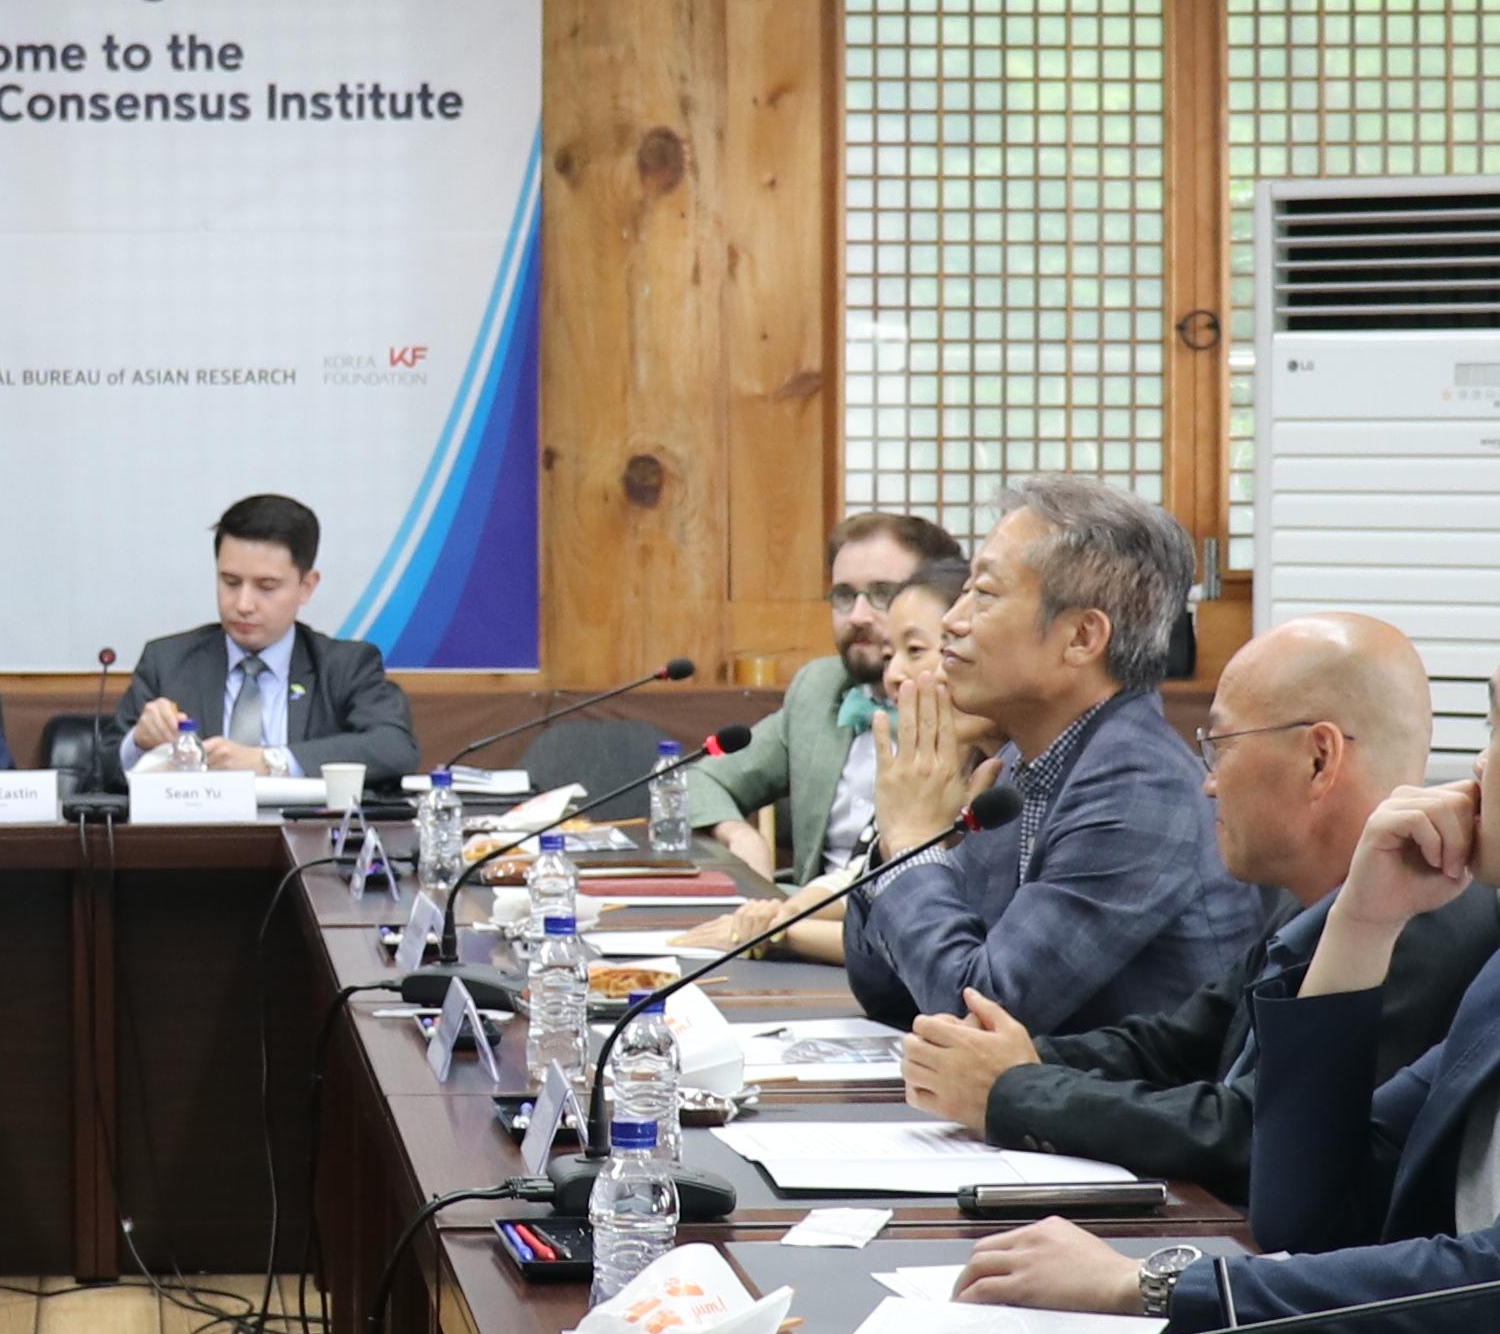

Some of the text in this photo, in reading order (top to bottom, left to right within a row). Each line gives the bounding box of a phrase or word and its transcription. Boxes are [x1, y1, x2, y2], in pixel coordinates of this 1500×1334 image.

[100, 33, 153, 73] to
[165, 33, 245, 73] the
[266, 81, 465, 122] Institute
[322, 345, 430, 369] KOREA KF
[21, 368, 101, 387] BUREAU
[106, 367, 126, 386] of
[131, 368, 190, 386] ASIAN
[195, 368, 297, 386] RESEARCH
[322, 371, 429, 387] FOUNDATION
[164, 787, 200, 799] Sean
